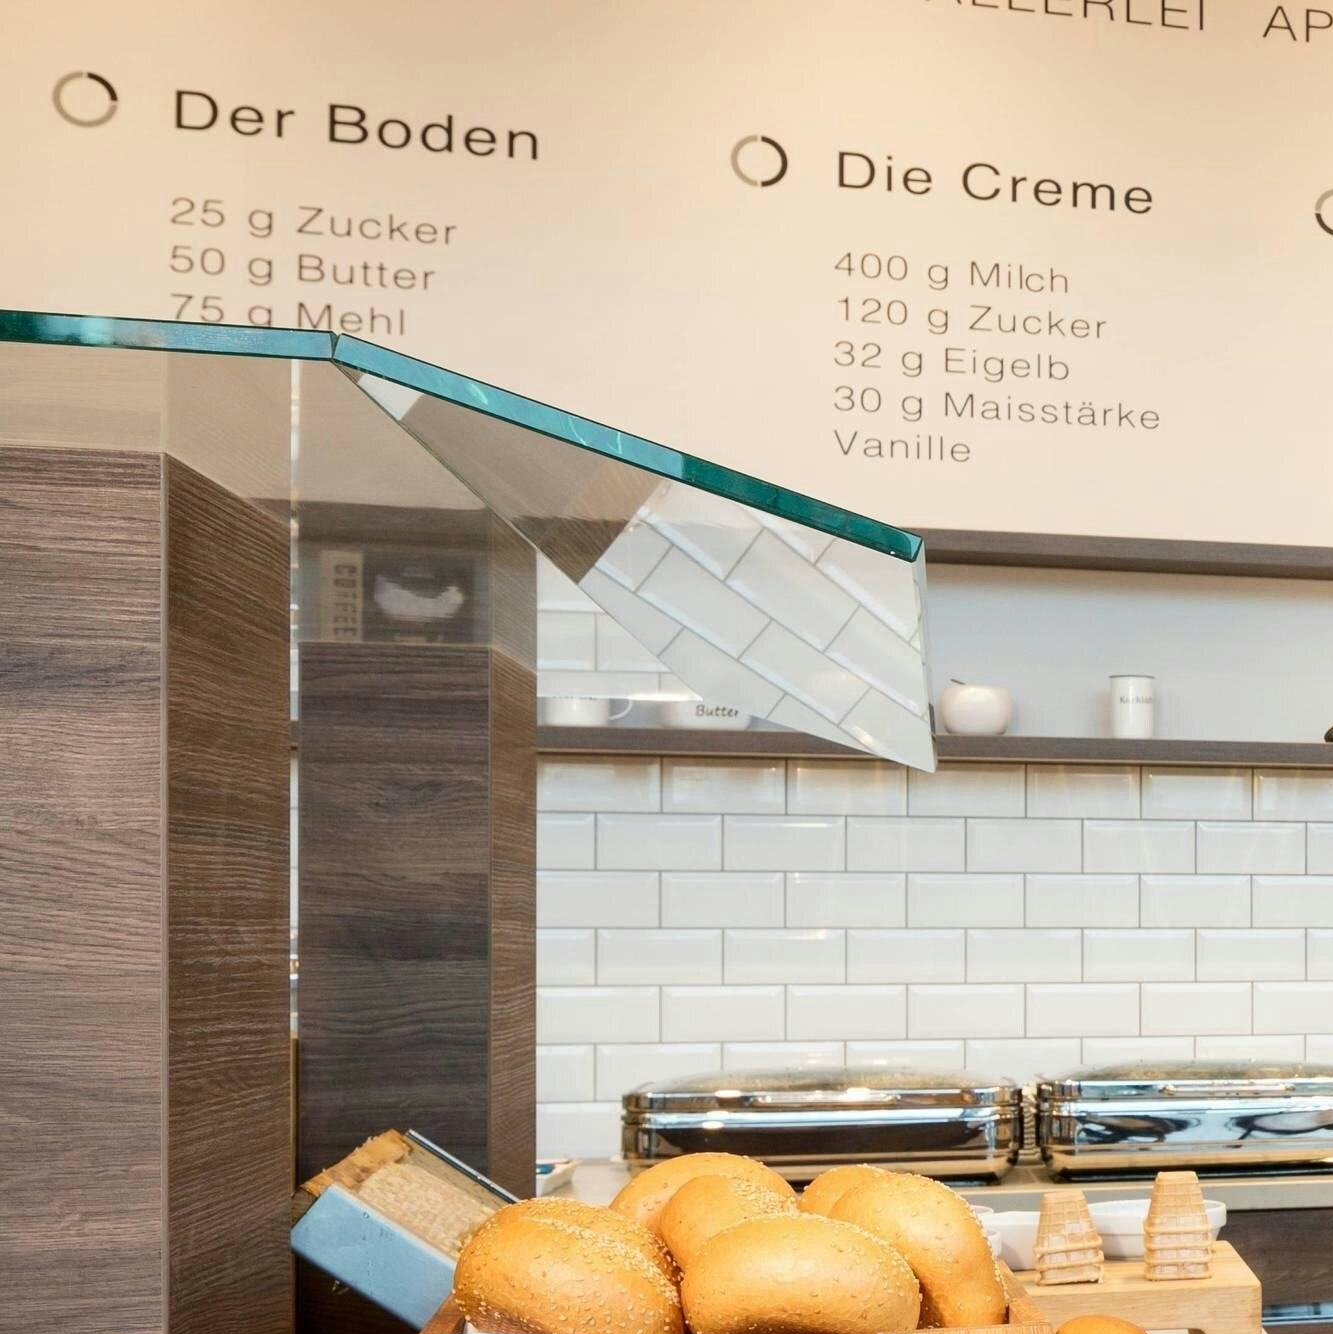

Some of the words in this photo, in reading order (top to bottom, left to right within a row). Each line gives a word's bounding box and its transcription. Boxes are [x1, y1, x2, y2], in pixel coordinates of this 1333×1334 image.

[174, 88, 297, 139] Der
[327, 102, 539, 162] Boden
[837, 150, 933, 196] Die
[961, 162, 1153, 215] Creme
[170, 196, 226, 228] 25
[247, 209, 274, 239] g
[296, 205, 457, 246] Zucker
[169, 244, 226, 276] 50
[247, 257, 273, 287] g
[297, 253, 436, 291] Butter
[834, 251, 909, 281] 400
[927, 264, 949, 291] g
[970, 260, 1069, 294] Milch
[170, 293, 225, 322] 75
[297, 301, 405, 335] Mehl
[837, 295, 908, 326] 120
[927, 308, 949, 336] g
[968, 304, 1107, 339] Zucker
[833, 340, 882, 369] 32
[901, 351, 923, 378] g
[944, 347, 1070, 384] Eigelb
[833, 385, 882, 413] 30
[901, 395, 923, 423] g
[944, 391, 1160, 430] Maisstärke
[833, 429, 971, 463] Vanille
[695, 704, 739, 718] Butter
